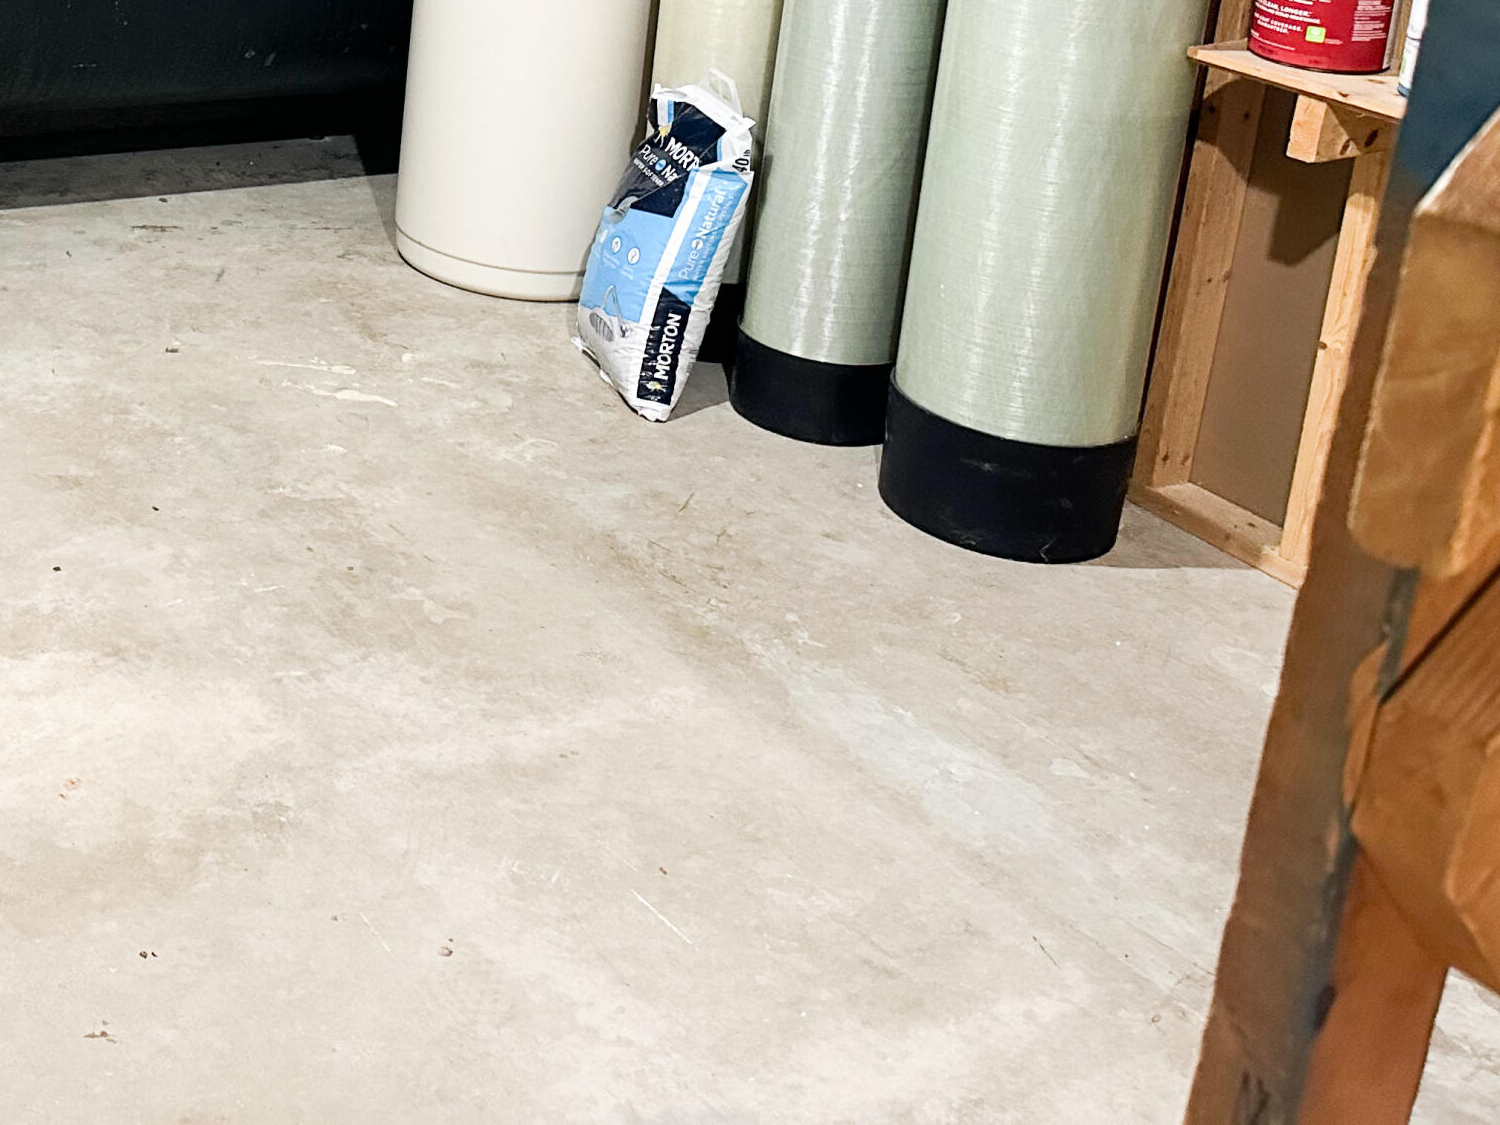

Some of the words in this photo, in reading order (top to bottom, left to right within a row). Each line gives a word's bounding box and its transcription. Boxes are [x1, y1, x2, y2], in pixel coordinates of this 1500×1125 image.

[731, 158, 749, 173] 40
[696, 189, 727, 239] Natural
[653, 312, 682, 381] MORTON
